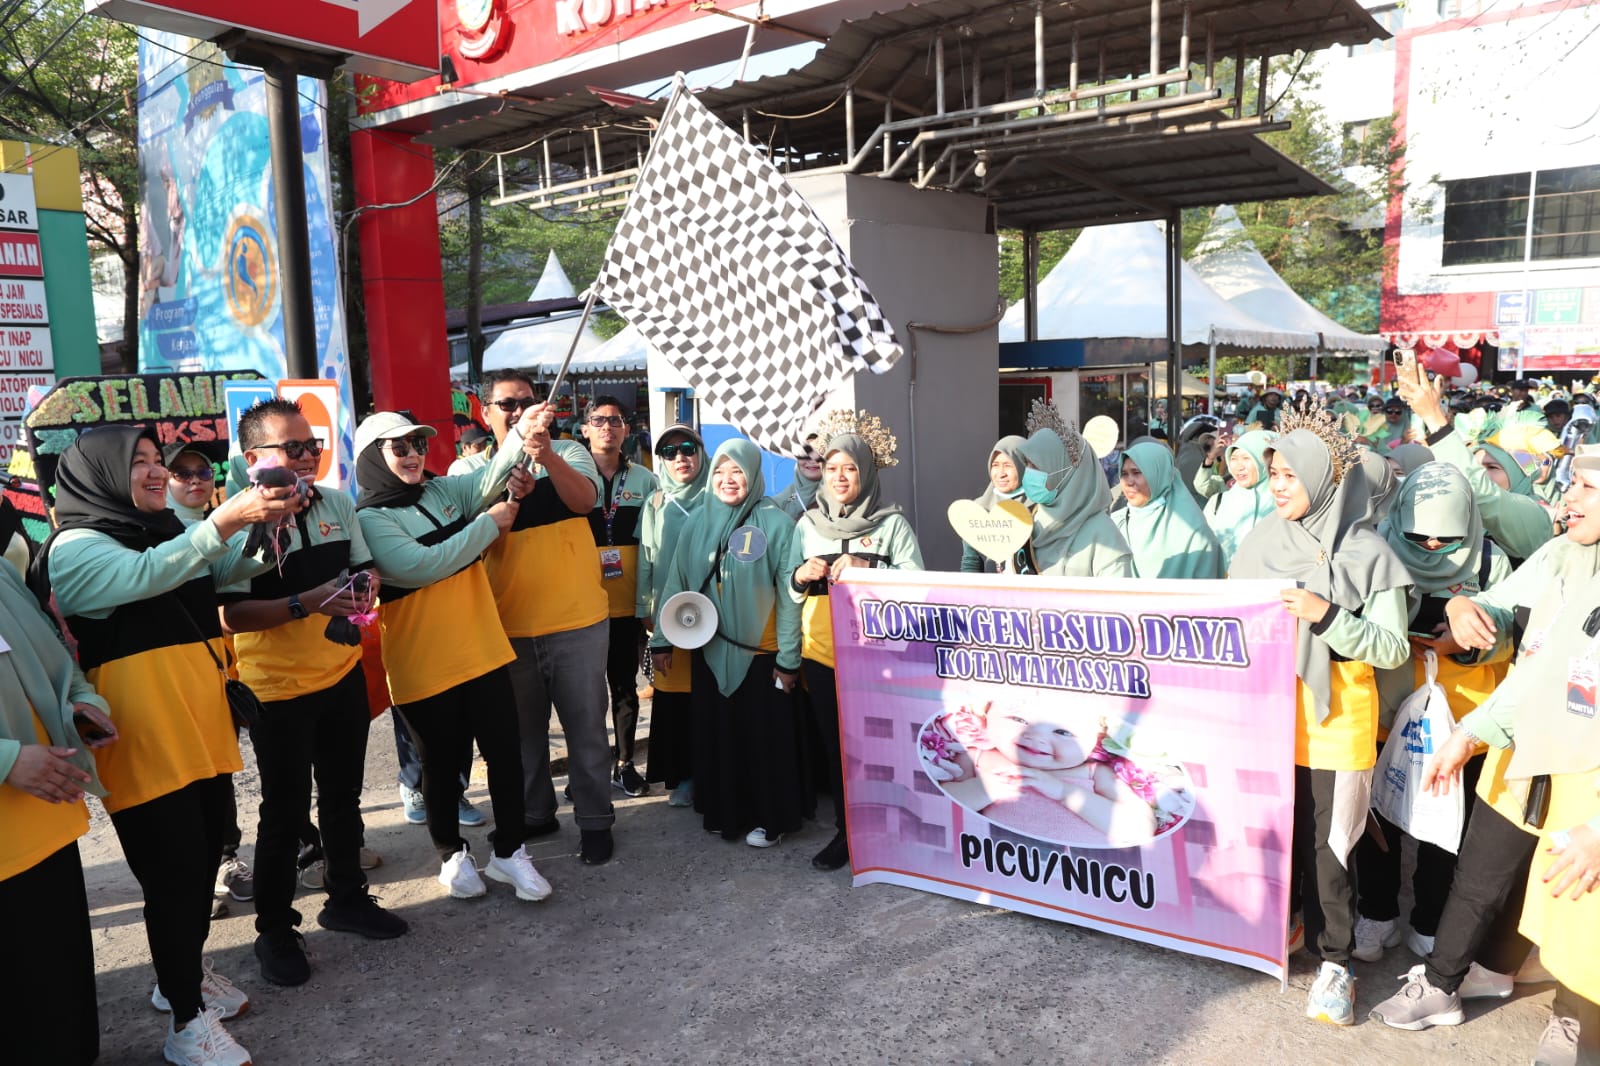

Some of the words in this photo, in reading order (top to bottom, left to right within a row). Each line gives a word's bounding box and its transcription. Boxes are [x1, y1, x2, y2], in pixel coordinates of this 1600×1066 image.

[6, 284, 25, 300] JAM
[1, 303, 44, 319] SPESIALIS
[155, 307, 185, 323] Program
[8, 331, 31, 346] INAP
[18, 350, 43, 366] NICU
[968, 519, 1013, 529] SELAMAT
[738, 530, 753, 555] 1
[861, 599, 1034, 651] KONTINGEN
[1036, 609, 1135, 657] RSUD
[1138, 613, 1251, 668] DAYA
[936, 646, 1006, 684] KOTA
[1006, 651, 1151, 699] MAKASSAR
[960, 832, 1156, 911] PICU/NICU
